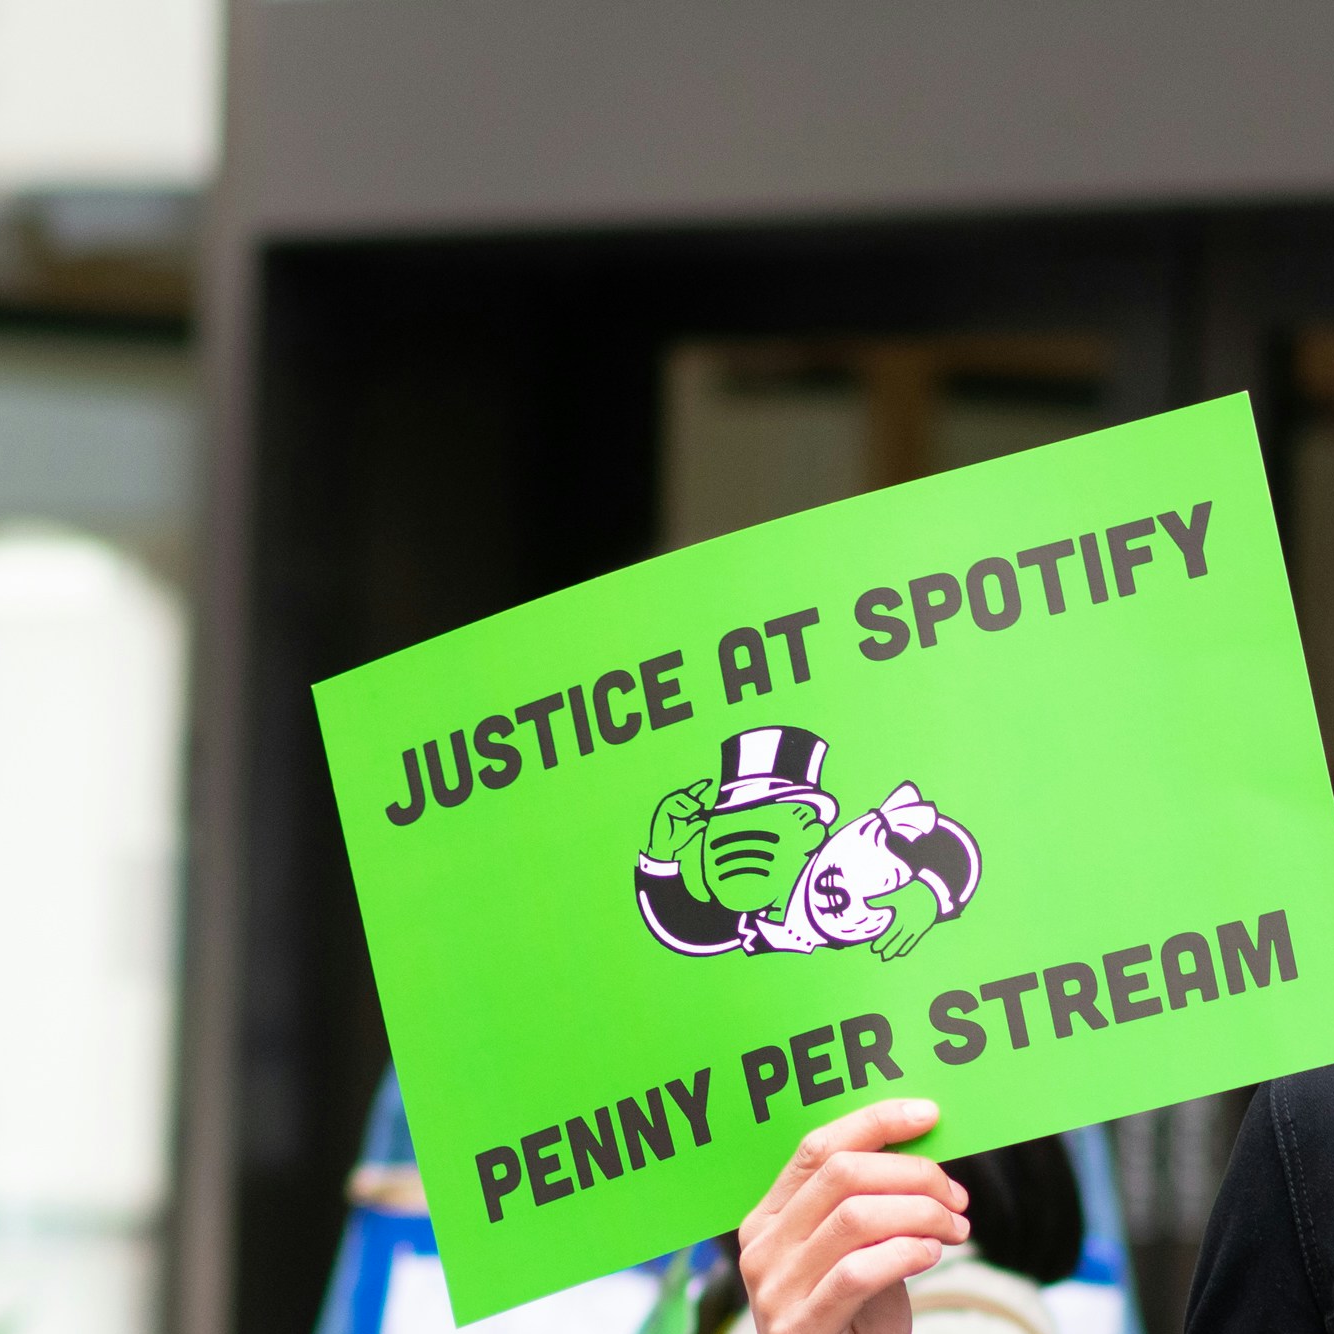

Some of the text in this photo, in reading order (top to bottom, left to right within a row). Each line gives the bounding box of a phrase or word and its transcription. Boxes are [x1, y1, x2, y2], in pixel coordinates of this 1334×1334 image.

[385, 650, 693, 826] JUSTICE
[718, 607, 821, 704] AT
[854, 500, 1213, 662] SPOTIFY
[474, 909, 1299, 1223] PENNY PER STREAM
